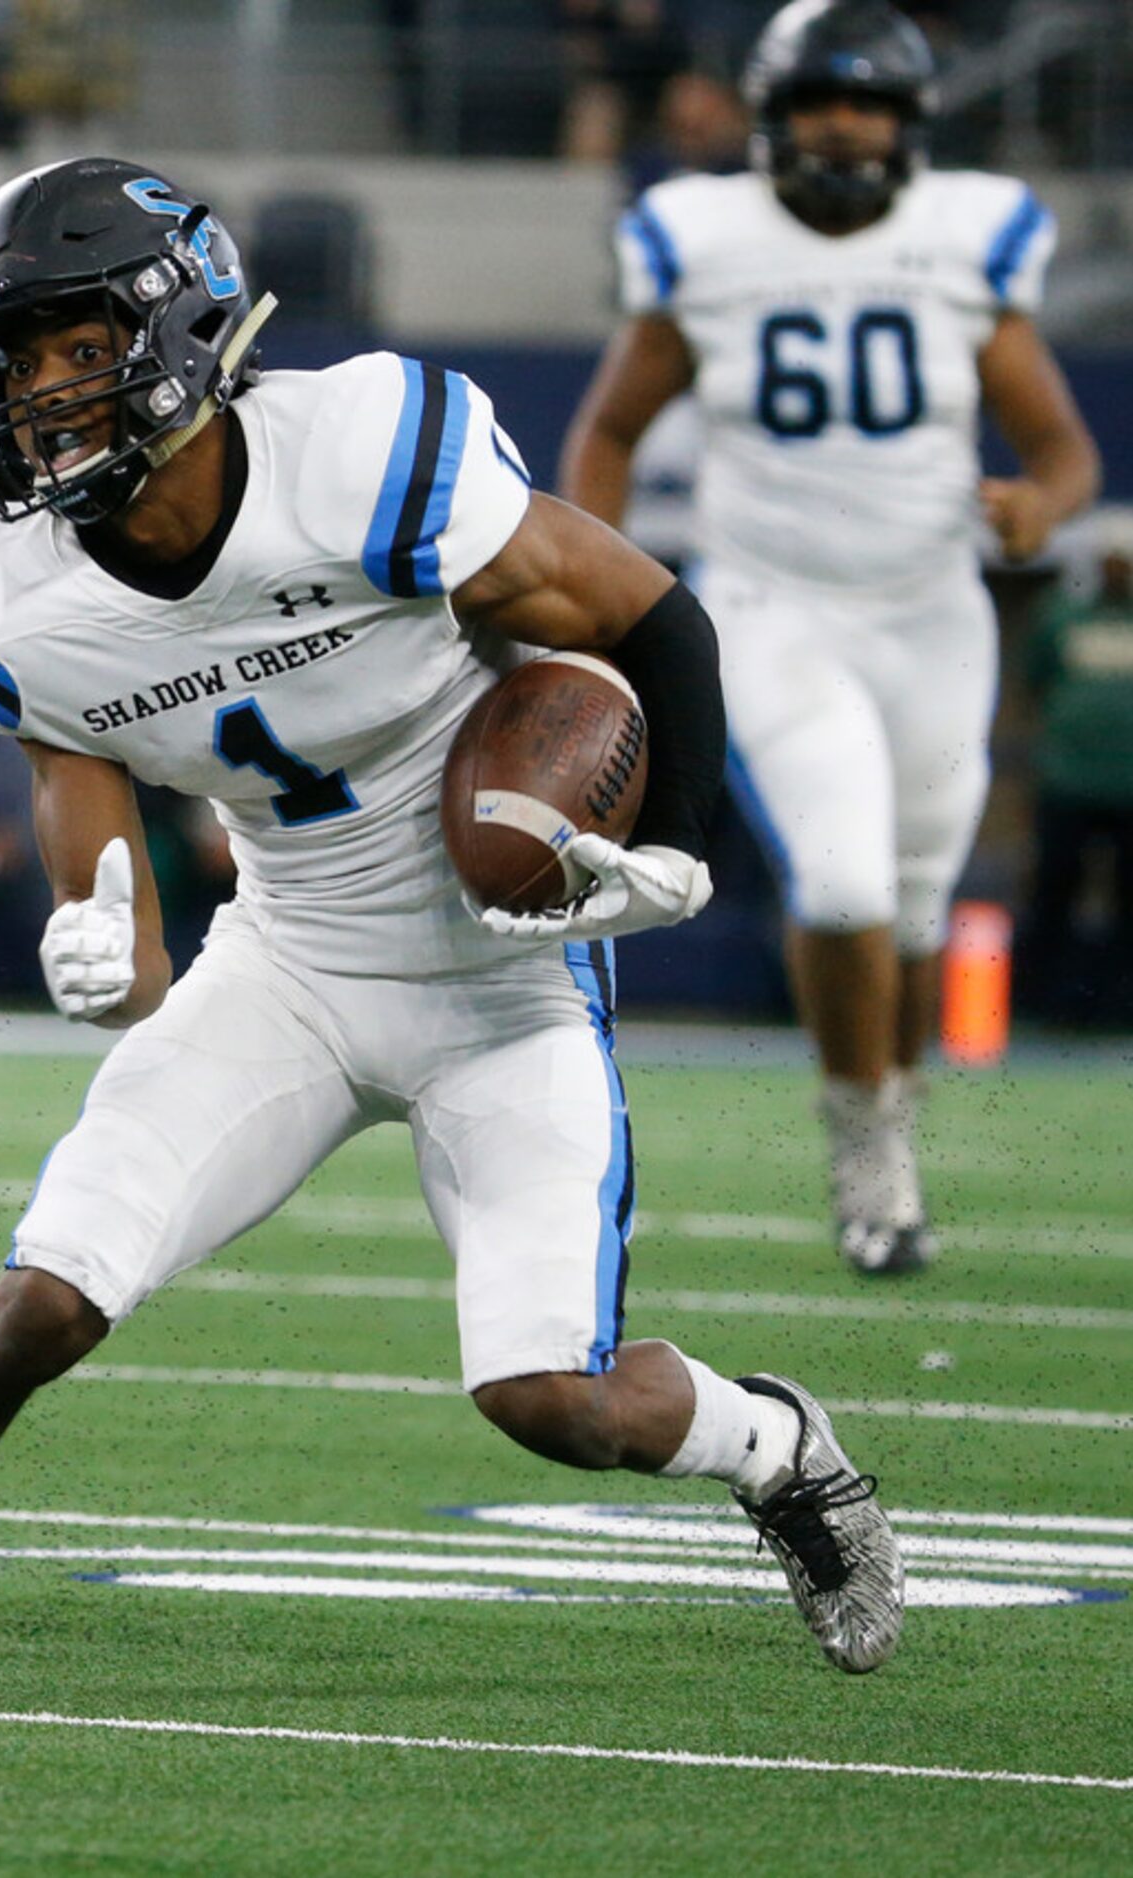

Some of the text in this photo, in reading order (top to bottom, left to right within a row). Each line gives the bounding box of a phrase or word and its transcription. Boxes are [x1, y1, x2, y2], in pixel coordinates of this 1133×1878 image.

[756, 306, 925, 438] 60
[82, 626, 354, 733] SHADOW CREEK
[212, 695, 362, 828] 1
